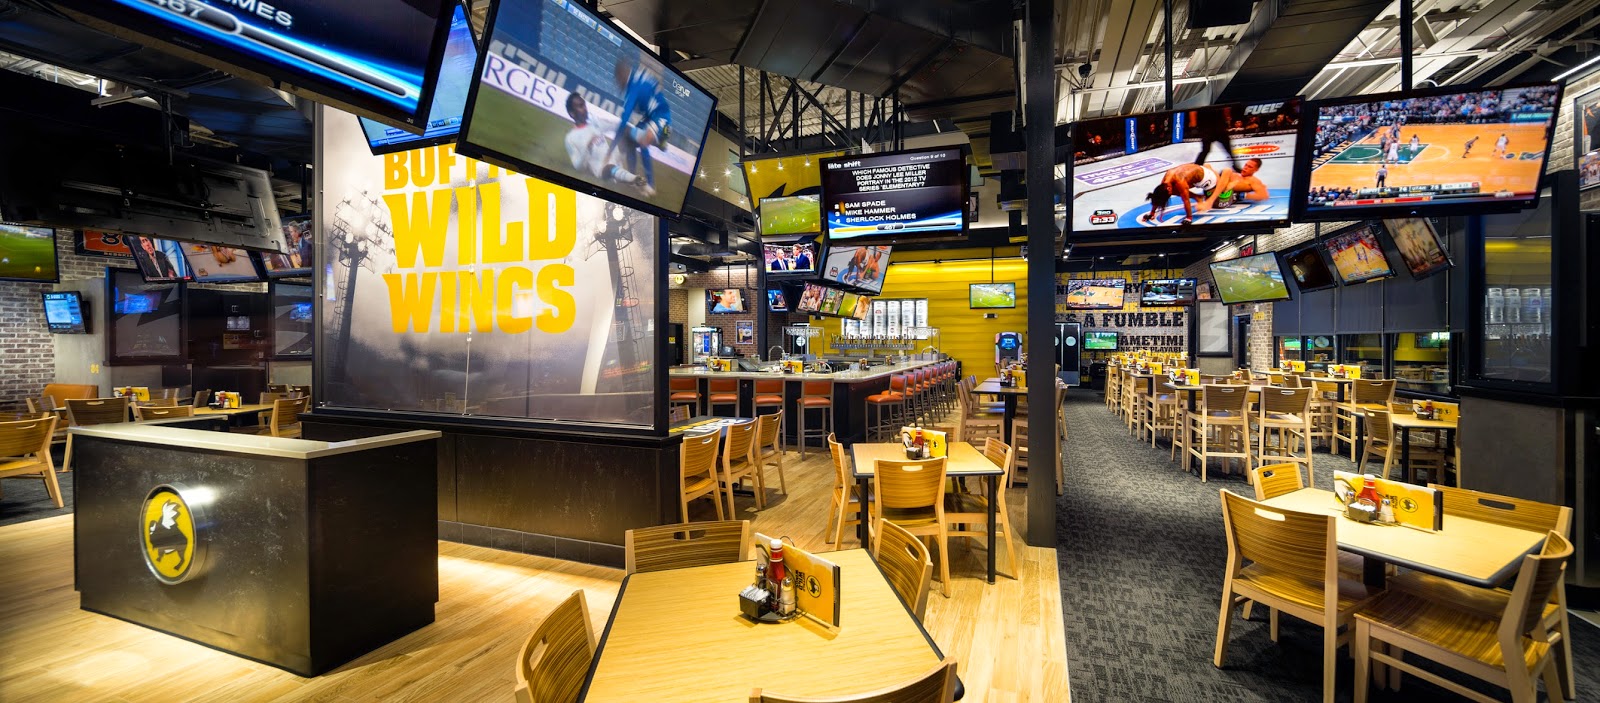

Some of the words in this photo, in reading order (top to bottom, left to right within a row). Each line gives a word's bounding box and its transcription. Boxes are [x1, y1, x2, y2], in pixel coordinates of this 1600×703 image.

[1244, 104, 1277, 115] FUEL
[852, 168, 872, 176] WHICH
[872, 166, 897, 174] FAMOUS
[897, 164, 931, 172] DETECTIVE
[872, 172, 892, 180] JONNY
[905, 169, 927, 177] MILLER
[857, 179, 884, 187] PORTRAY
[904, 175, 918, 183] 2012
[862, 200, 886, 208] SPADE
[864, 206, 896, 215] HAMMER
[382, 177, 576, 268] WILD
[846, 216, 885, 224] SHERLOCK
[885, 213, 917, 221] HOLMES
[382, 263, 576, 333] WINGS
[1084, 313, 1096, 327] A
[1103, 313, 1183, 327] FUMBLE
